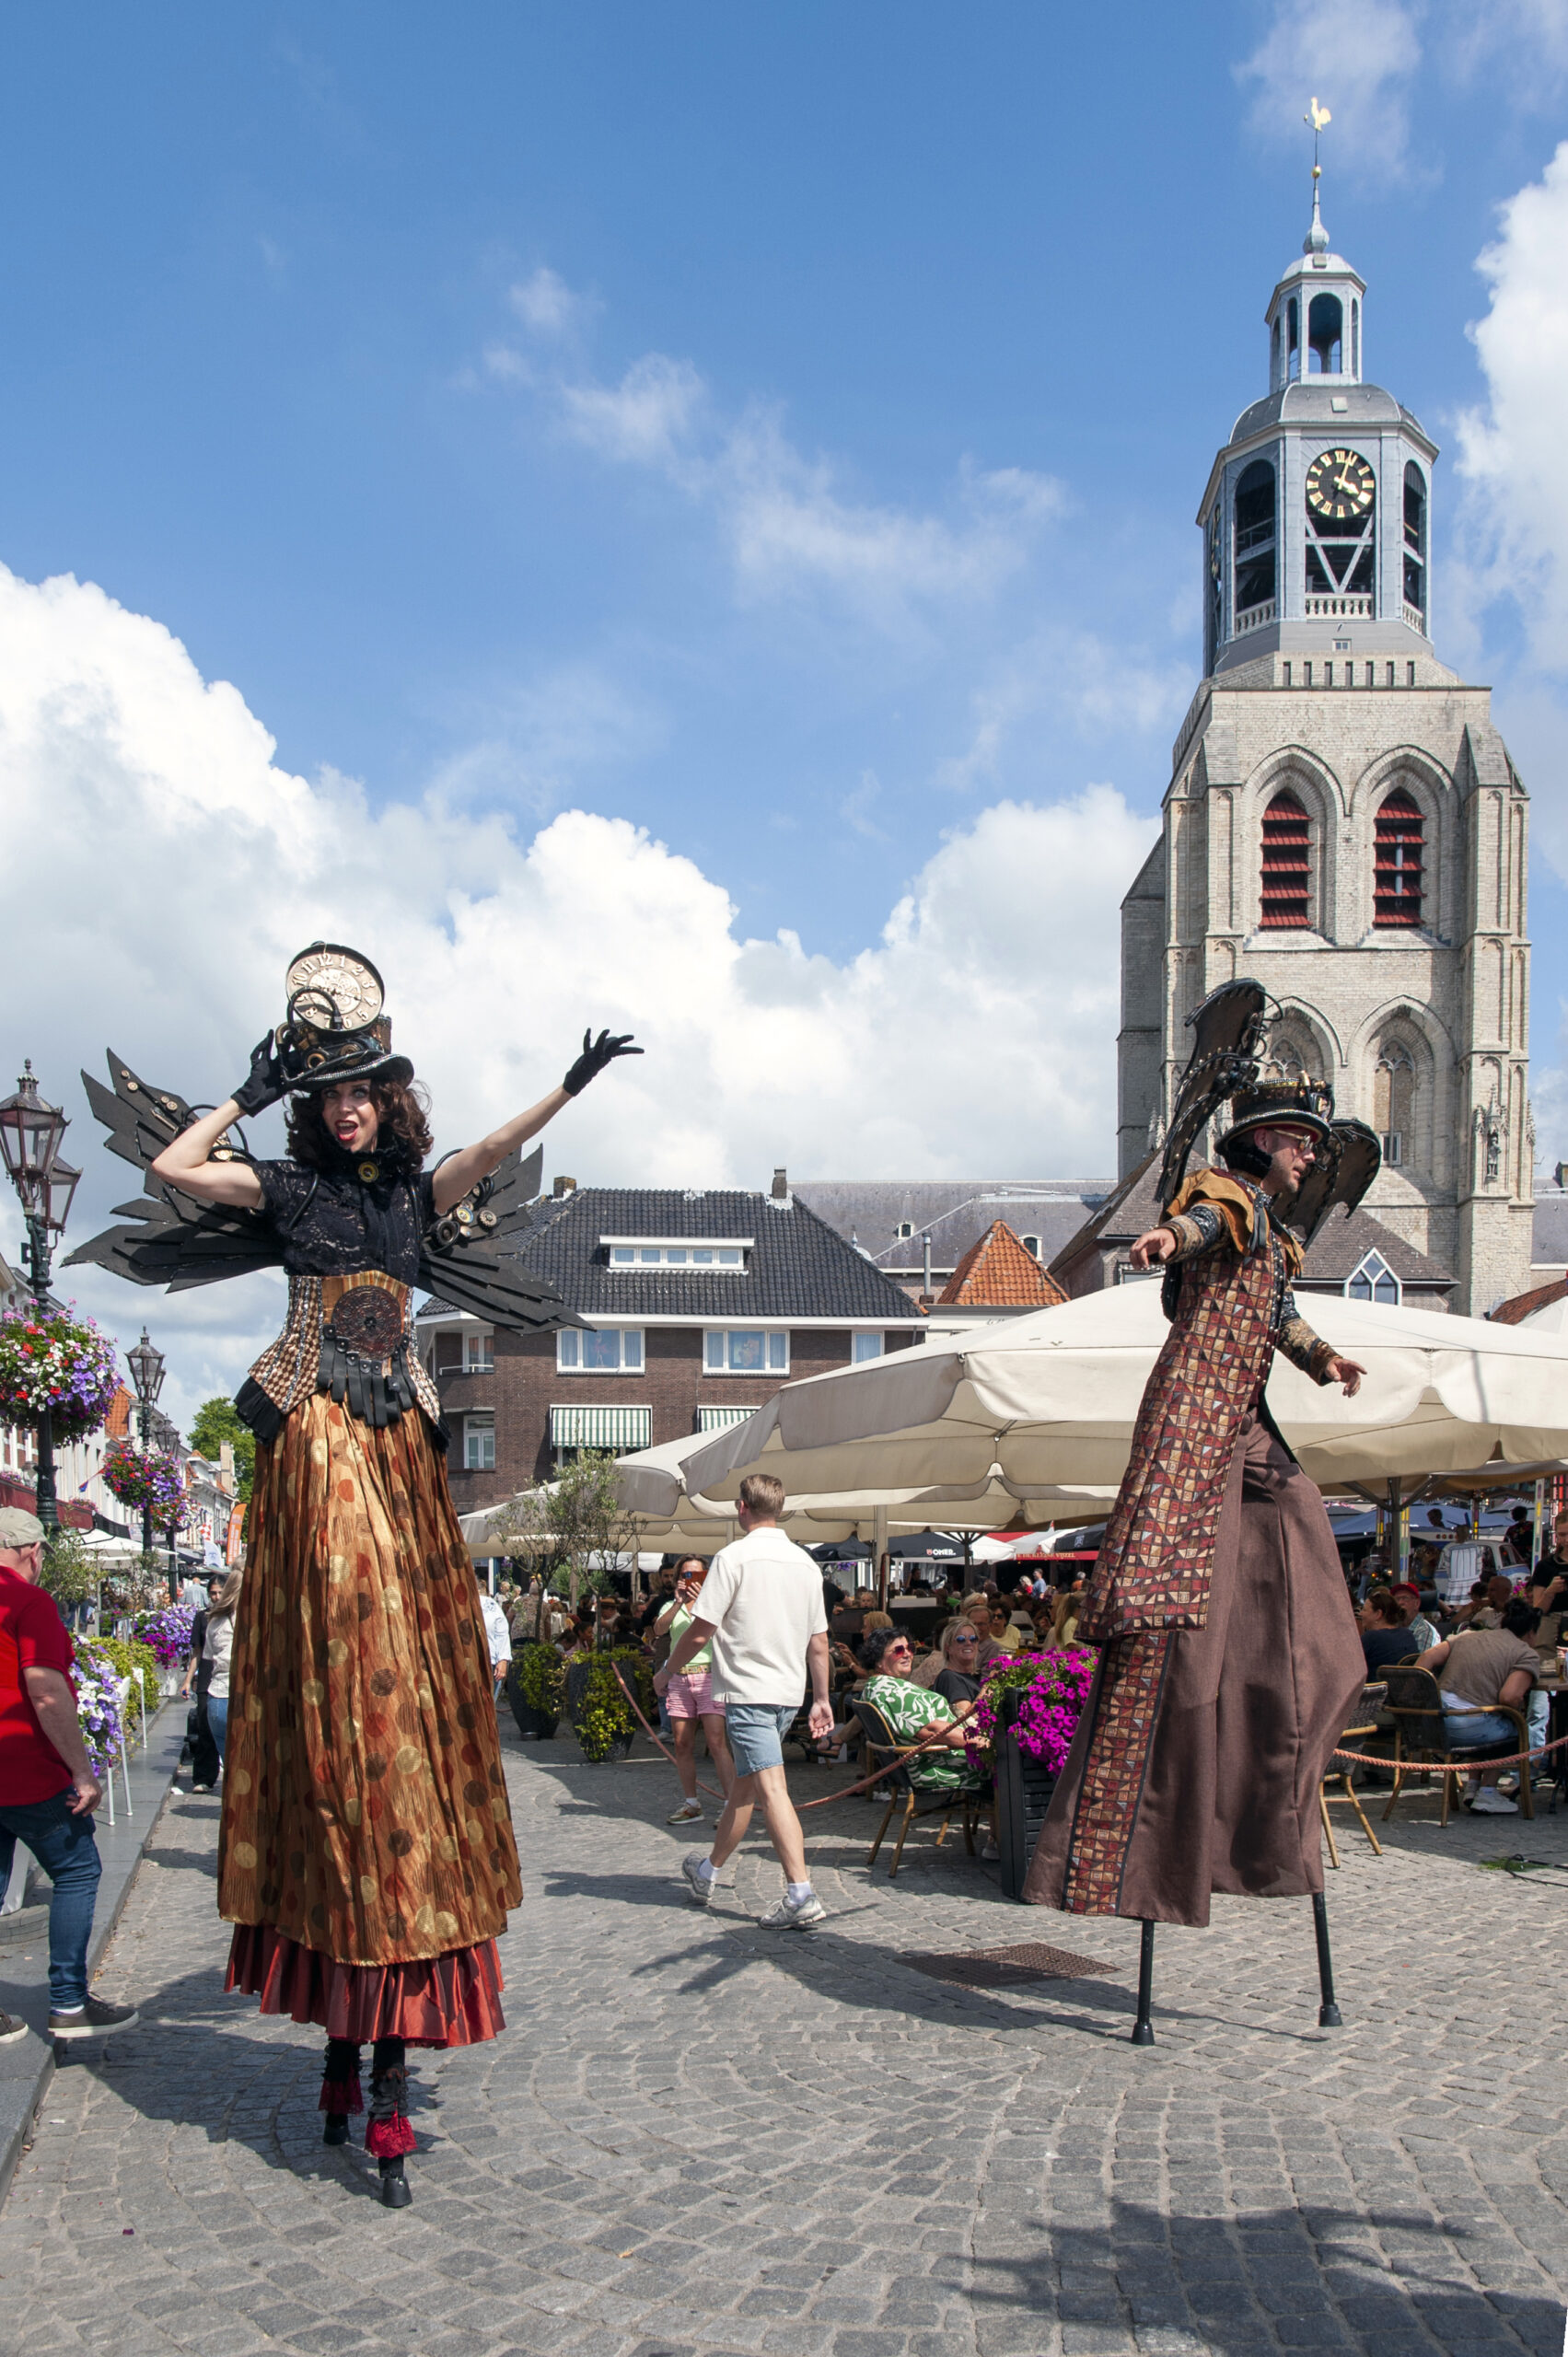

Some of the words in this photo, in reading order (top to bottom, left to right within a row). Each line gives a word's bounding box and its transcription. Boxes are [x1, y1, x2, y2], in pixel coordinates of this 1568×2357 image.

[301, 959, 317, 973] 11
[317, 953, 333, 967] 12
[339, 955, 346, 968] 1
[351, 964, 365, 976] 2
[292, 972, 308, 986] 10
[362, 980, 377, 989] 3
[364, 996, 377, 1007] 4
[305, 1006, 318, 1018] 8
[356, 1009, 369, 1022] 5
[343, 1016, 353, 1028] 6
